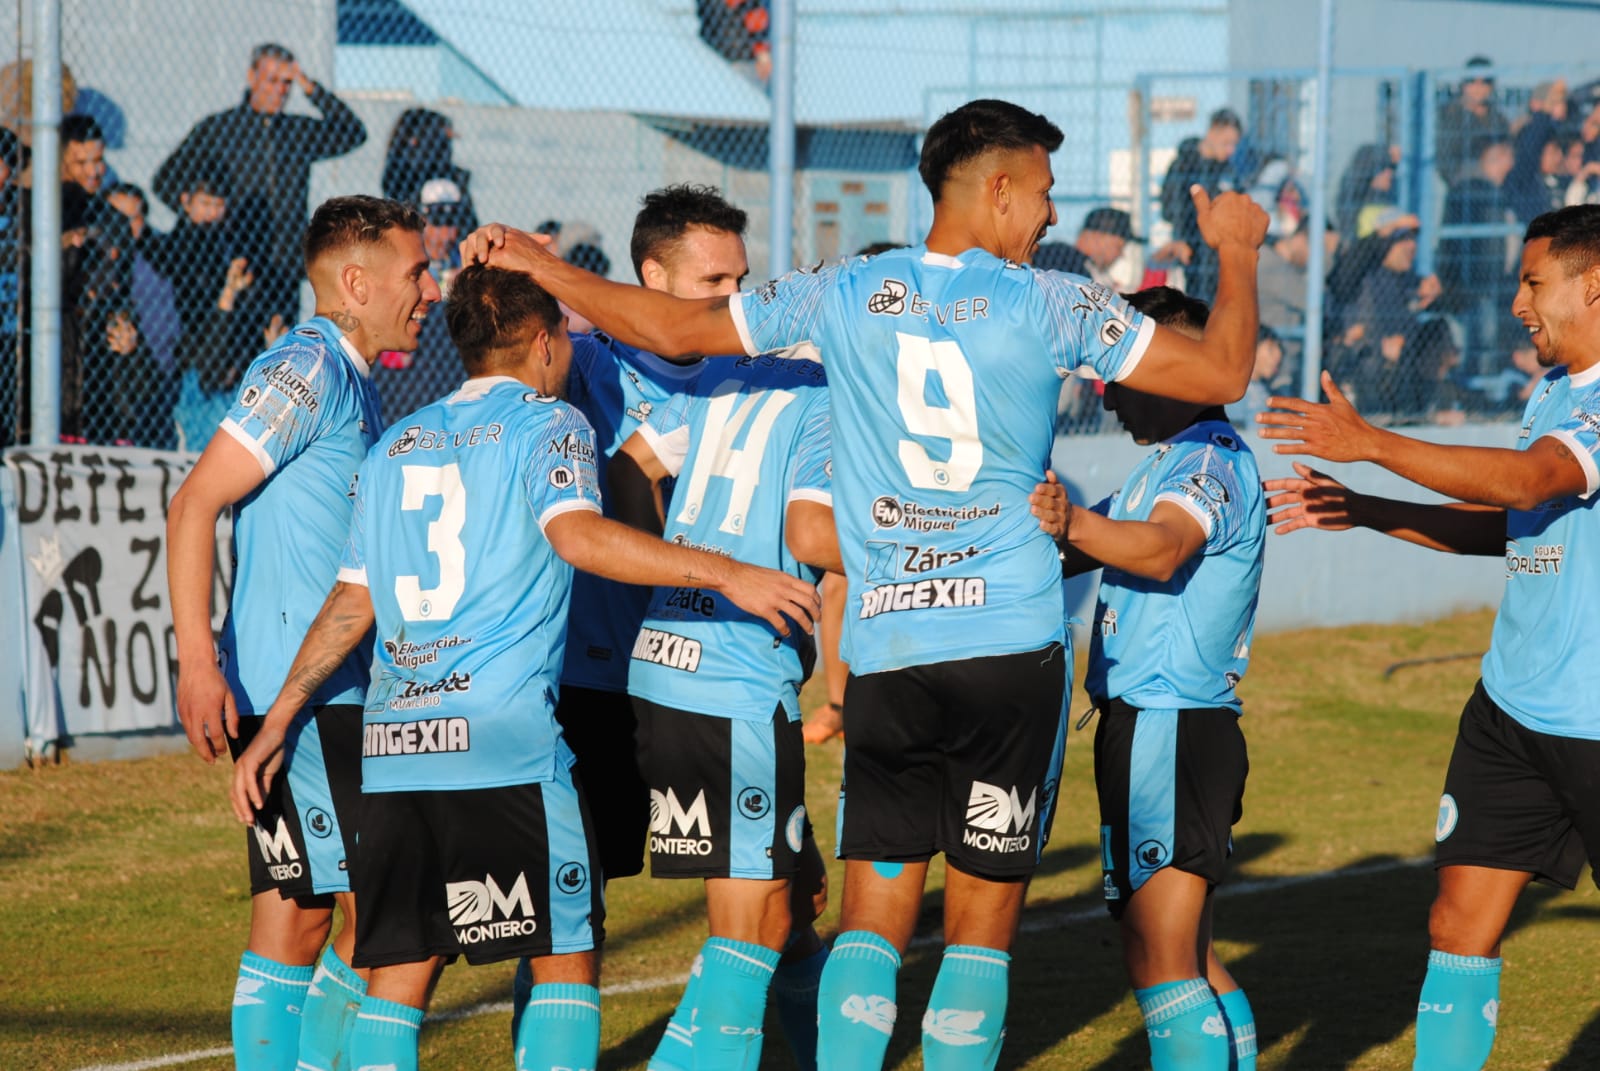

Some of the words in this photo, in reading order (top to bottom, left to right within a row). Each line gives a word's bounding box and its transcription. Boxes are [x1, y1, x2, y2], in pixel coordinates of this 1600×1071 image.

[896, 332, 983, 491] 9
[904, 503, 1000, 520] Electricidad
[904, 517, 957, 532] Miguel
[394, 463, 466, 622] 3
[1534, 545, 1564, 556] AGUAS
[904, 546, 992, 573] Zárat
[860, 577, 985, 619] ANGEXIA
[363, 719, 468, 757] ANGEXIA
[963, 829, 1030, 853] MONTERO
[454, 919, 536, 945] MONTERO
